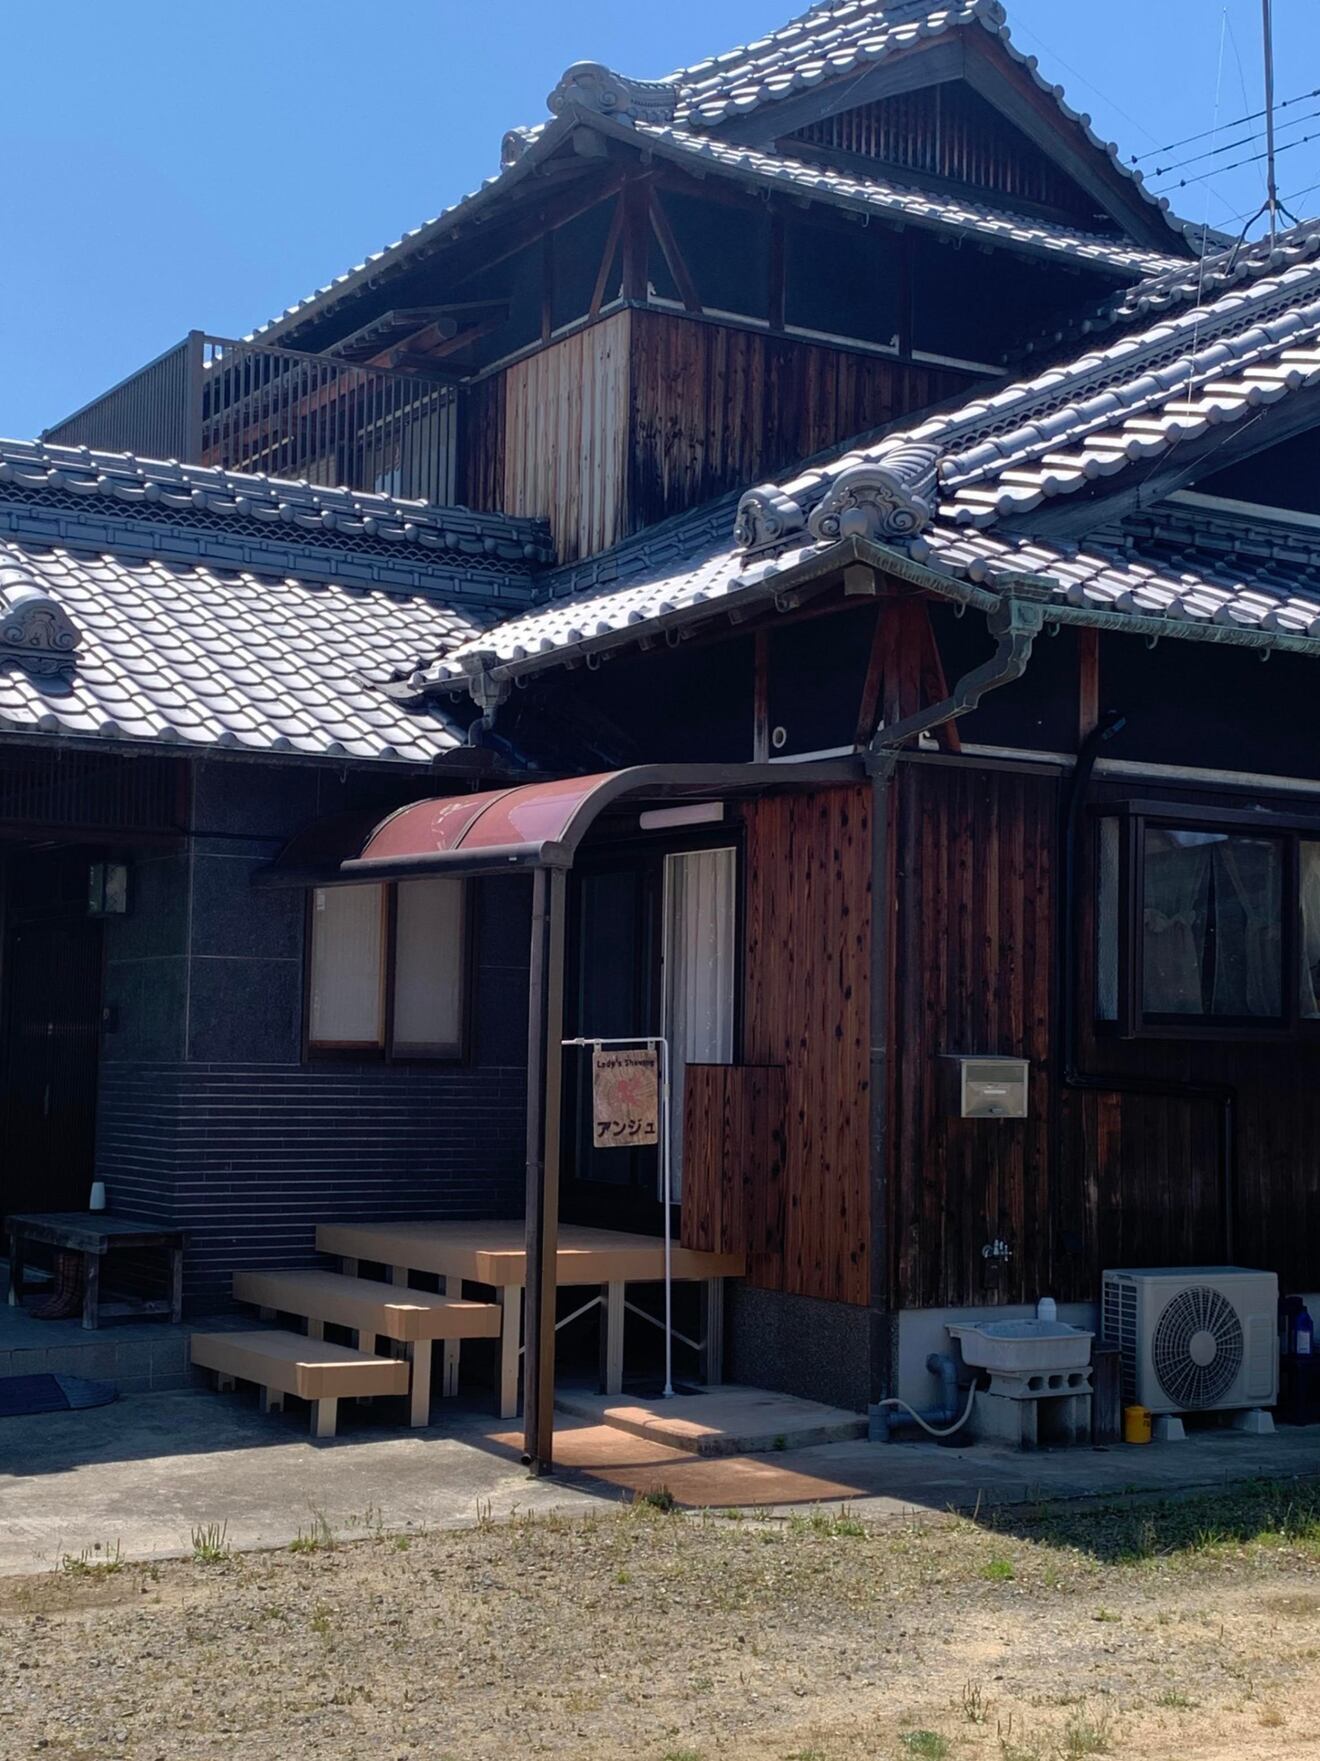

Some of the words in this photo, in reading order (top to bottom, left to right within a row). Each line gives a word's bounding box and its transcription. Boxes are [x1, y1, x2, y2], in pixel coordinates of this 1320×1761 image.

[597, 1057, 622, 1069] Lady's
[597, 1119, 656, 1138] アンジュ
